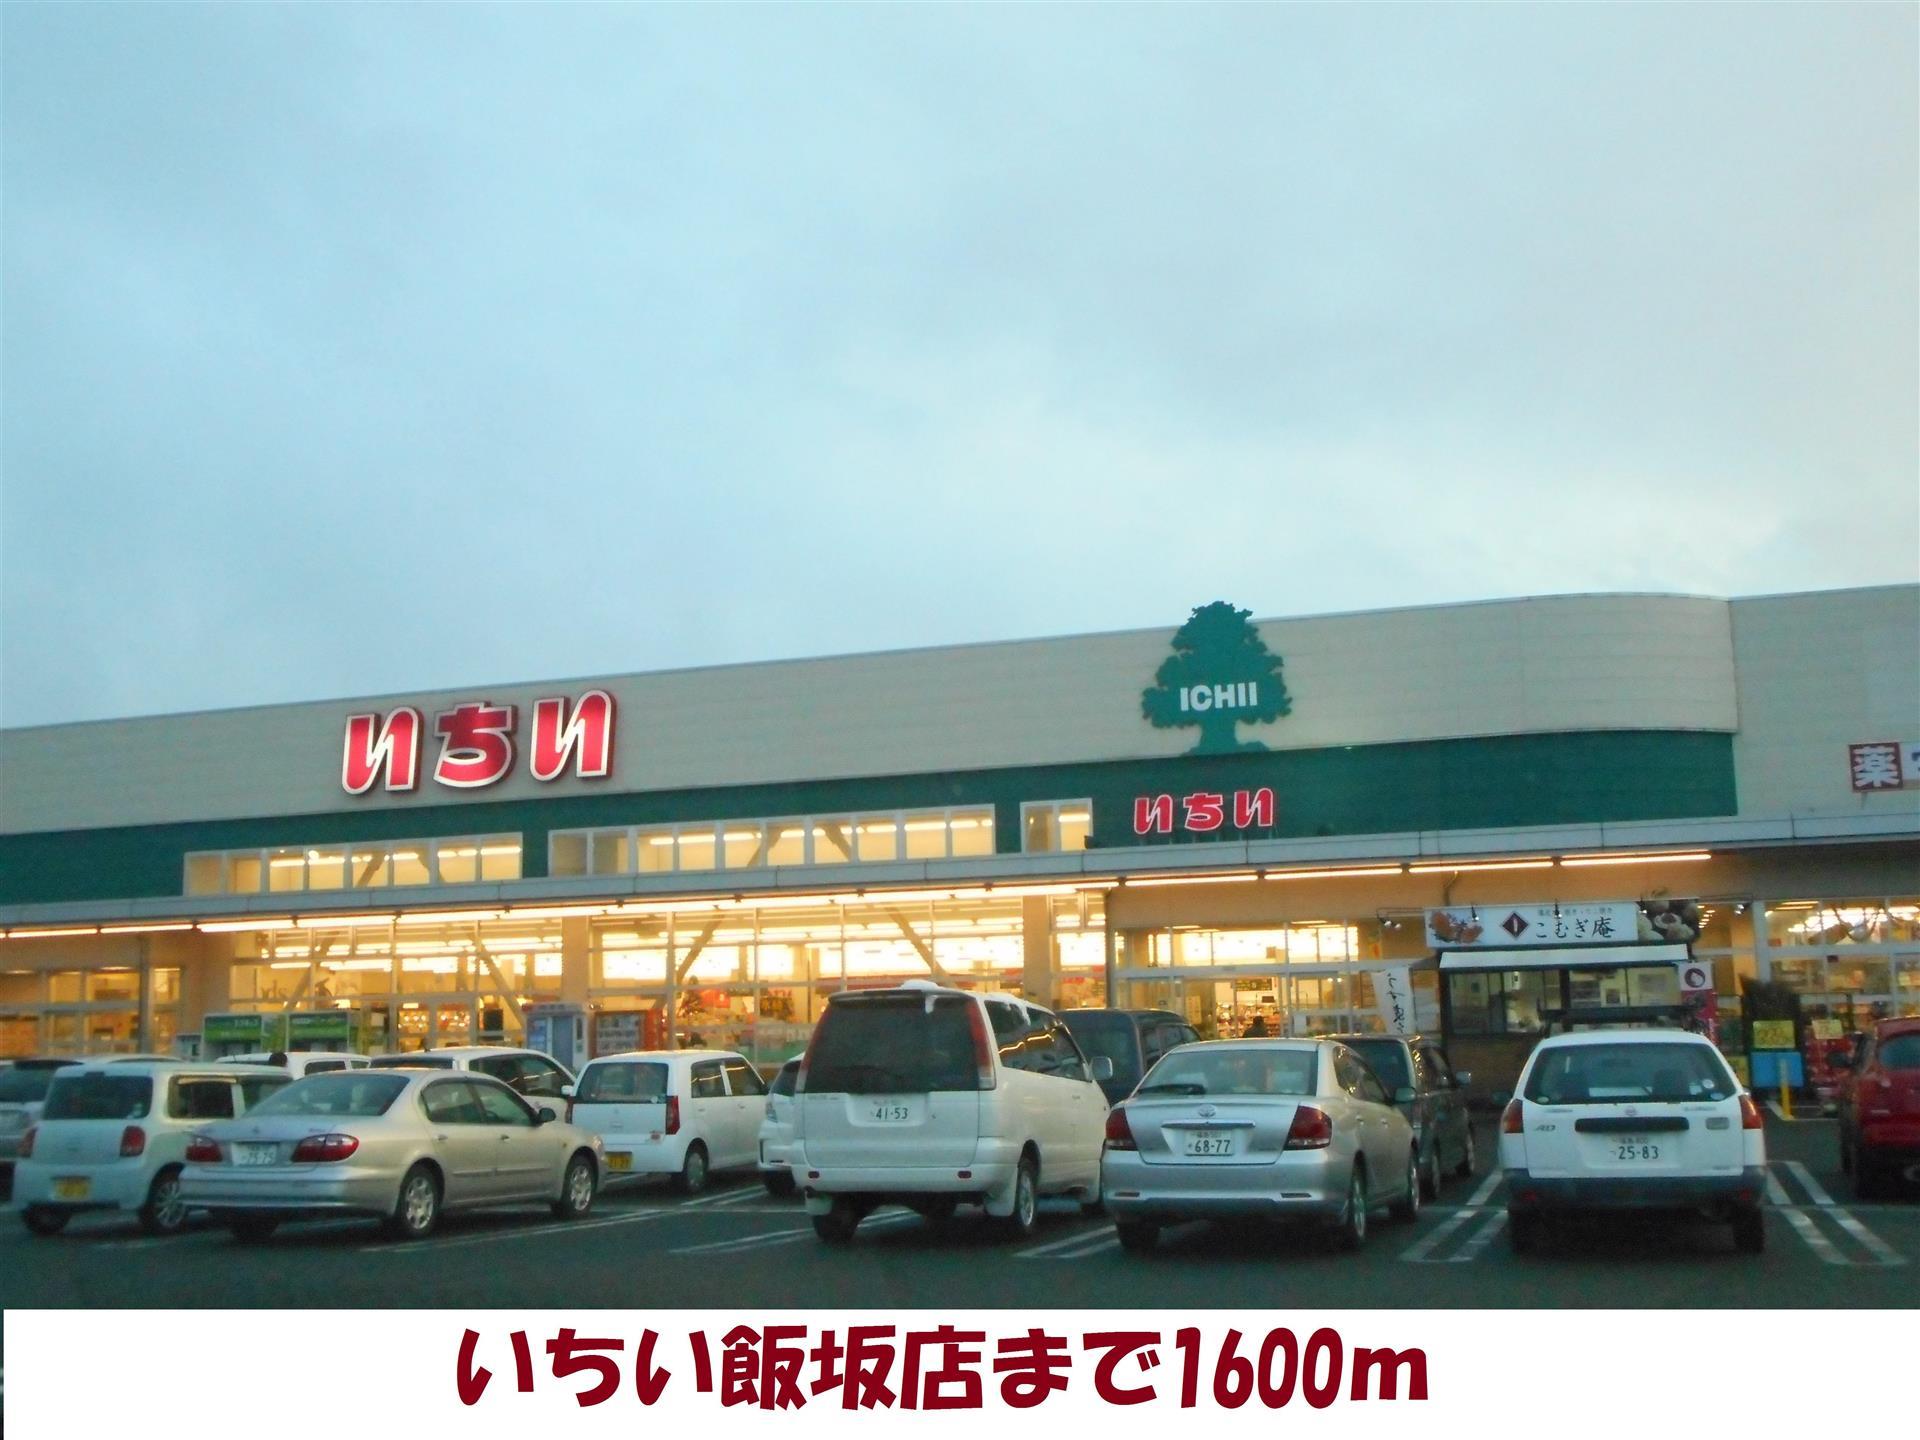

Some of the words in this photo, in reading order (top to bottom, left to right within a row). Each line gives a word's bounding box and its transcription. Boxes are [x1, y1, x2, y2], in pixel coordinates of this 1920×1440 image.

[1180, 681, 1258, 712] ICHII
[341, 689, 613, 795] いちい
[1853, 745, 1900, 788] 薬
[1134, 787, 1274, 835] いちい
[1535, 916, 1616, 938] こむぎ庵
[1194, 1139, 1231, 1153] 68-77
[1618, 1145, 1659, 1160] 25-83
